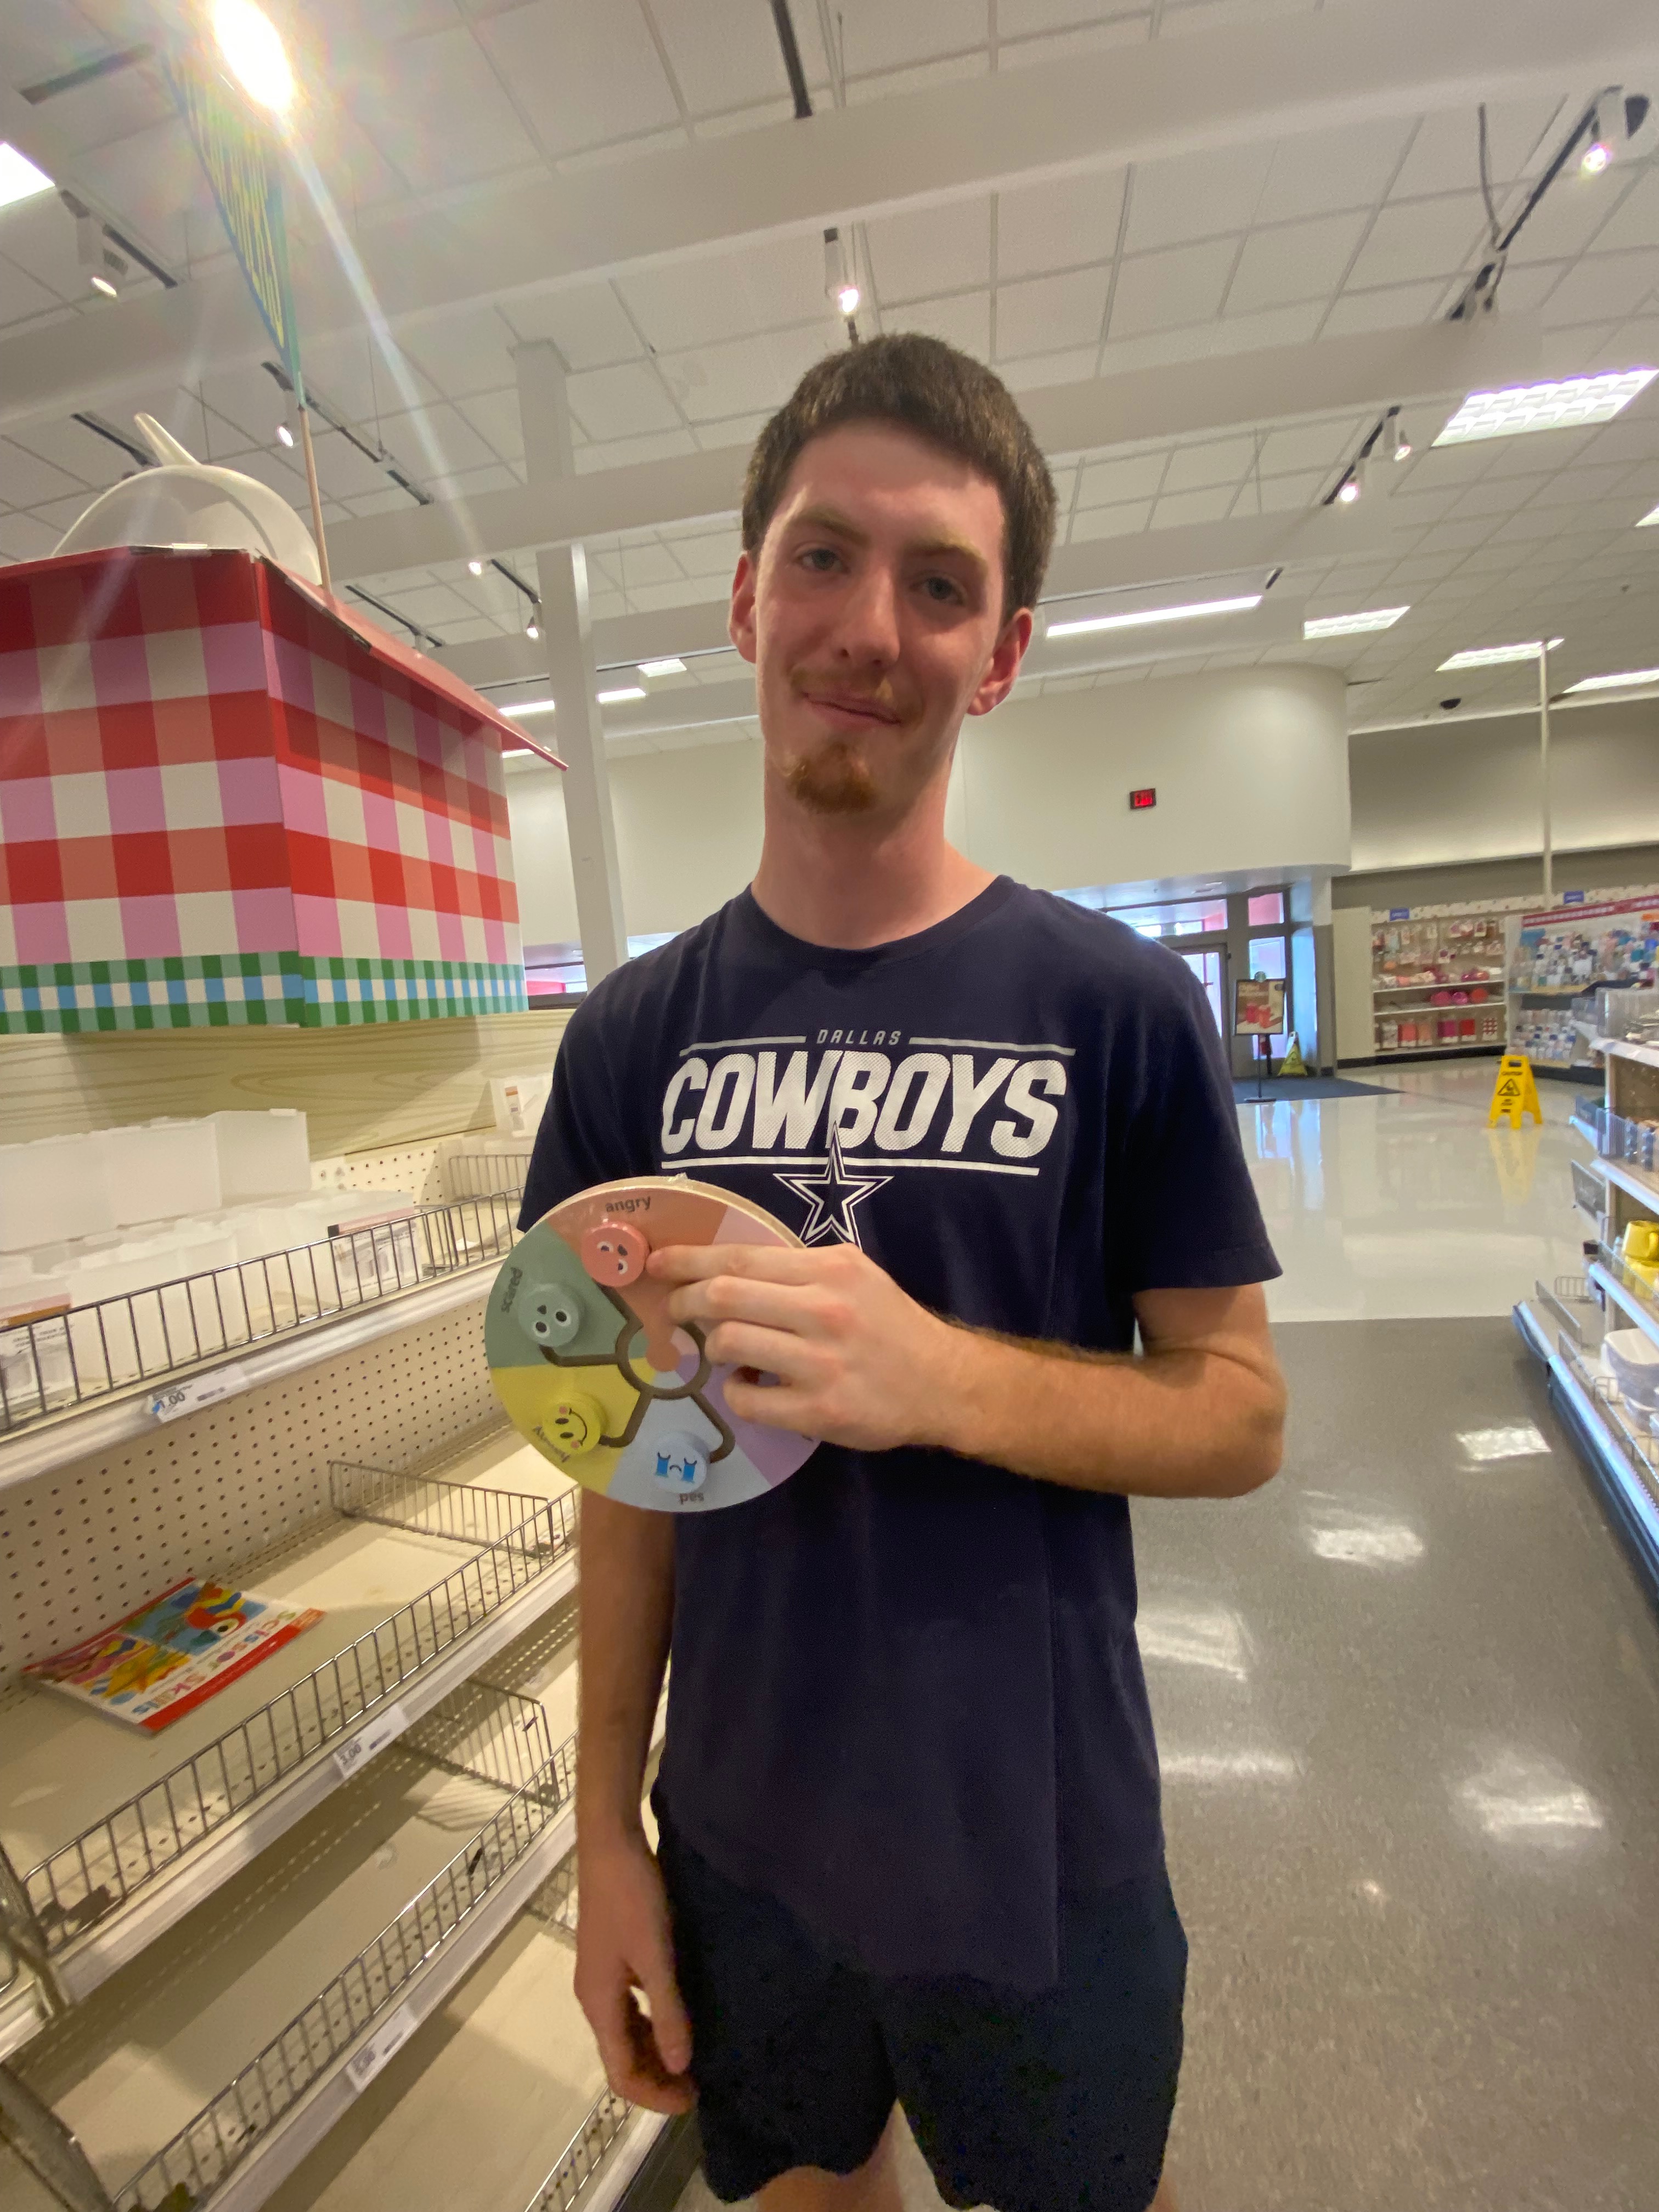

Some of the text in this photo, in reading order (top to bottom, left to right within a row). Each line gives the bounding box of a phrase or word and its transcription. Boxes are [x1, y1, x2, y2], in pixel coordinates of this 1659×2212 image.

[816, 1029, 902, 1046] DALLAS
[661, 1049, 1068, 1158] COWBOYS
[605, 1195, 651, 1213] angry
[500, 1267, 523, 1313] scared
[679, 1492, 705, 1505] sad
